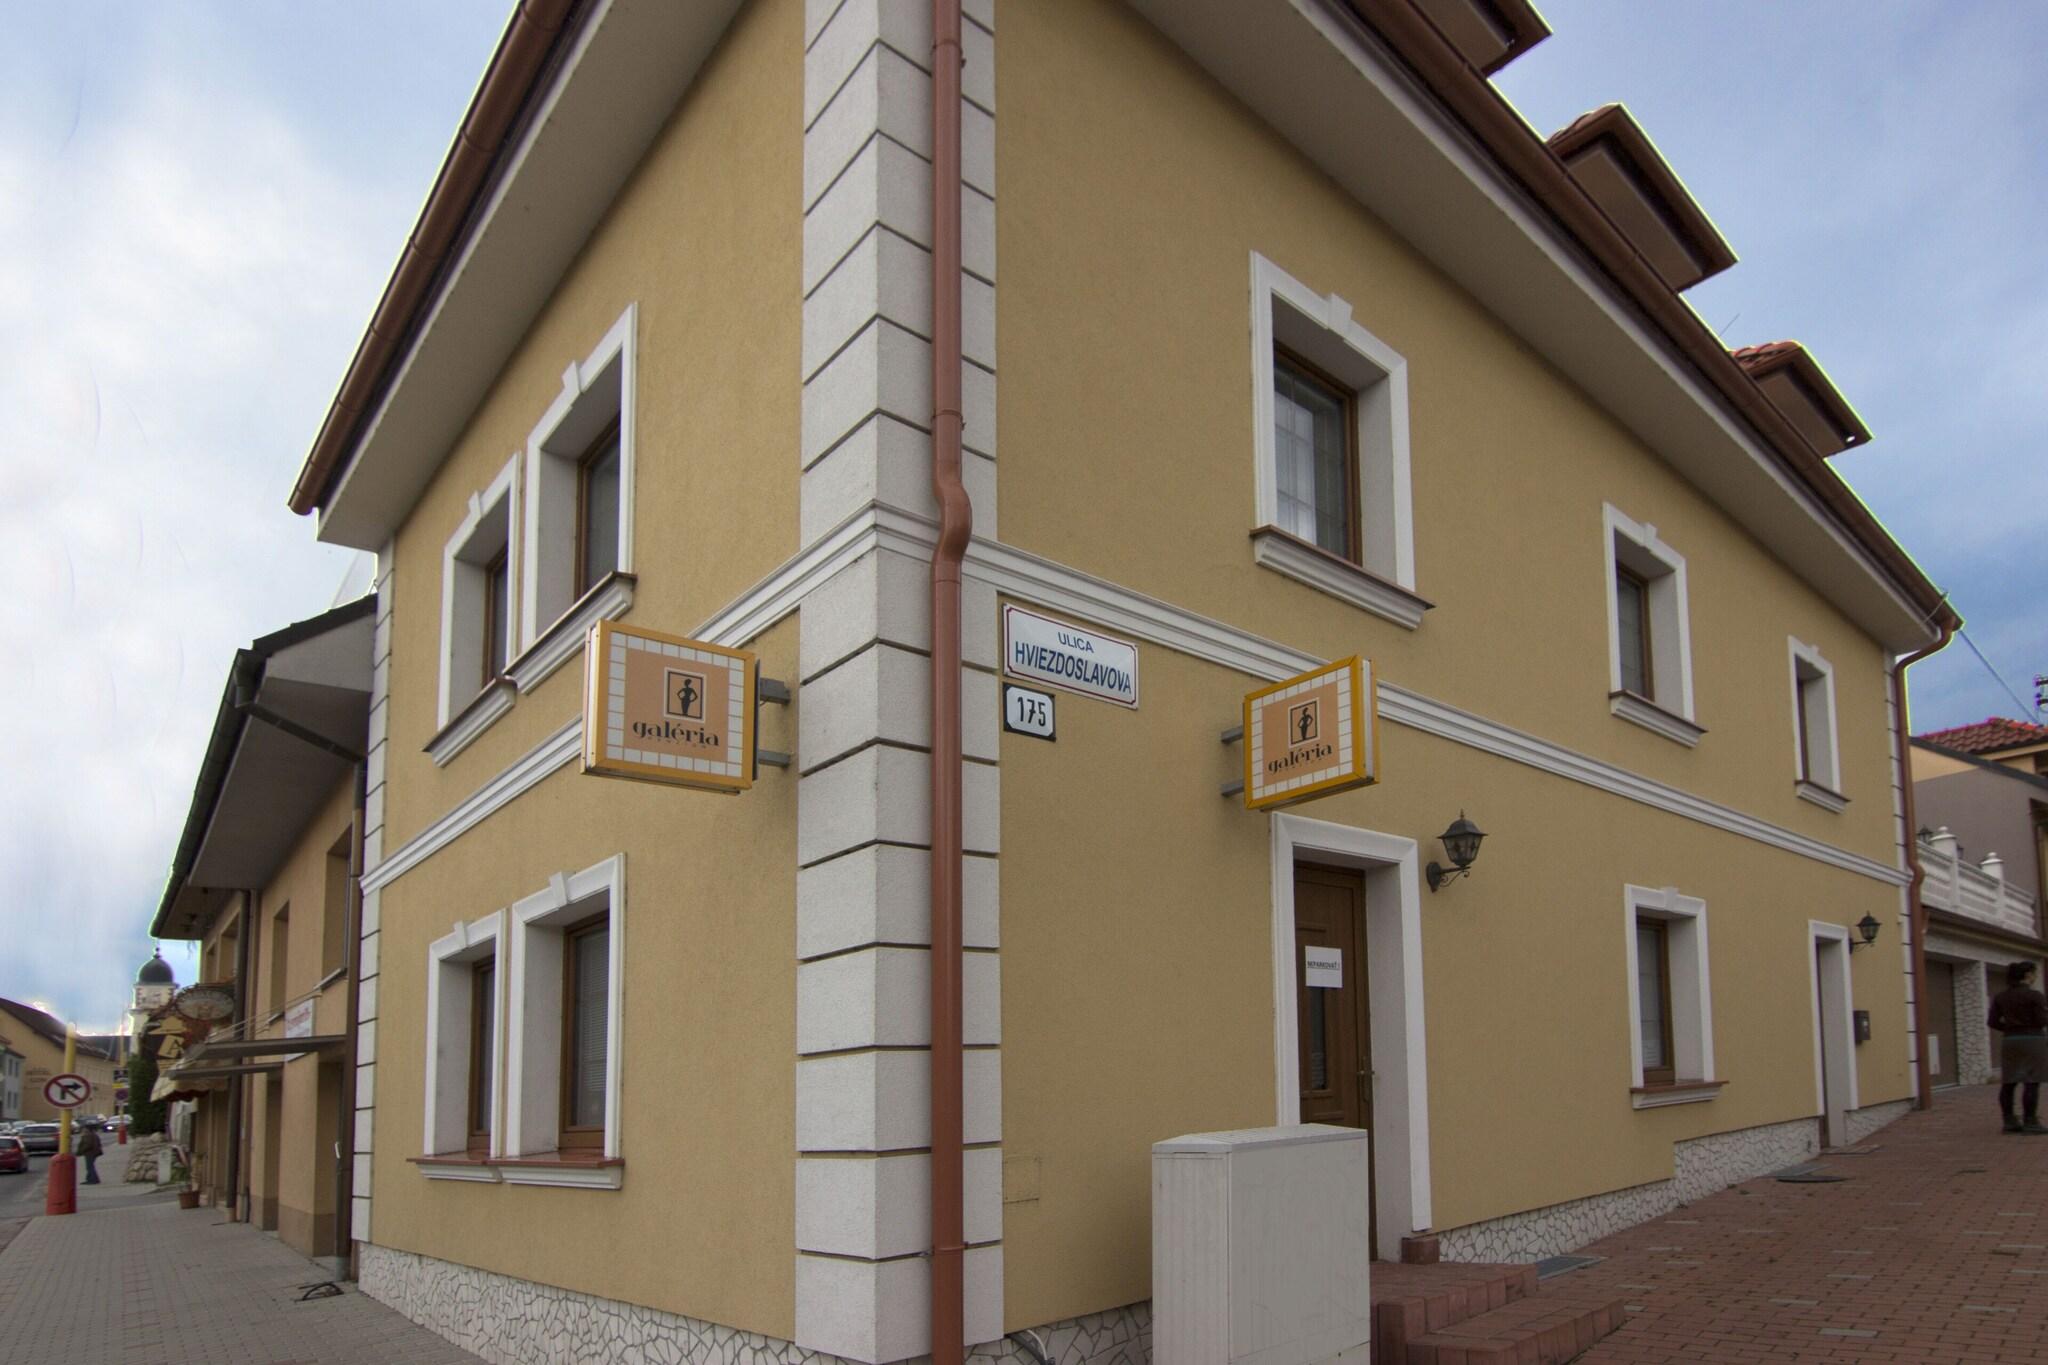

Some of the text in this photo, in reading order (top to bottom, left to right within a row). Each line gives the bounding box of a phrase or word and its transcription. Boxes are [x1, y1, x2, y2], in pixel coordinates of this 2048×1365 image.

[1057, 631, 1094, 653] ULICA
[1015, 641, 1132, 694] HVIEZDOSLAVOVA
[1017, 696, 1046, 727] 175
[633, 721, 719, 746] galéria
[1268, 743, 1332, 775] galéria
